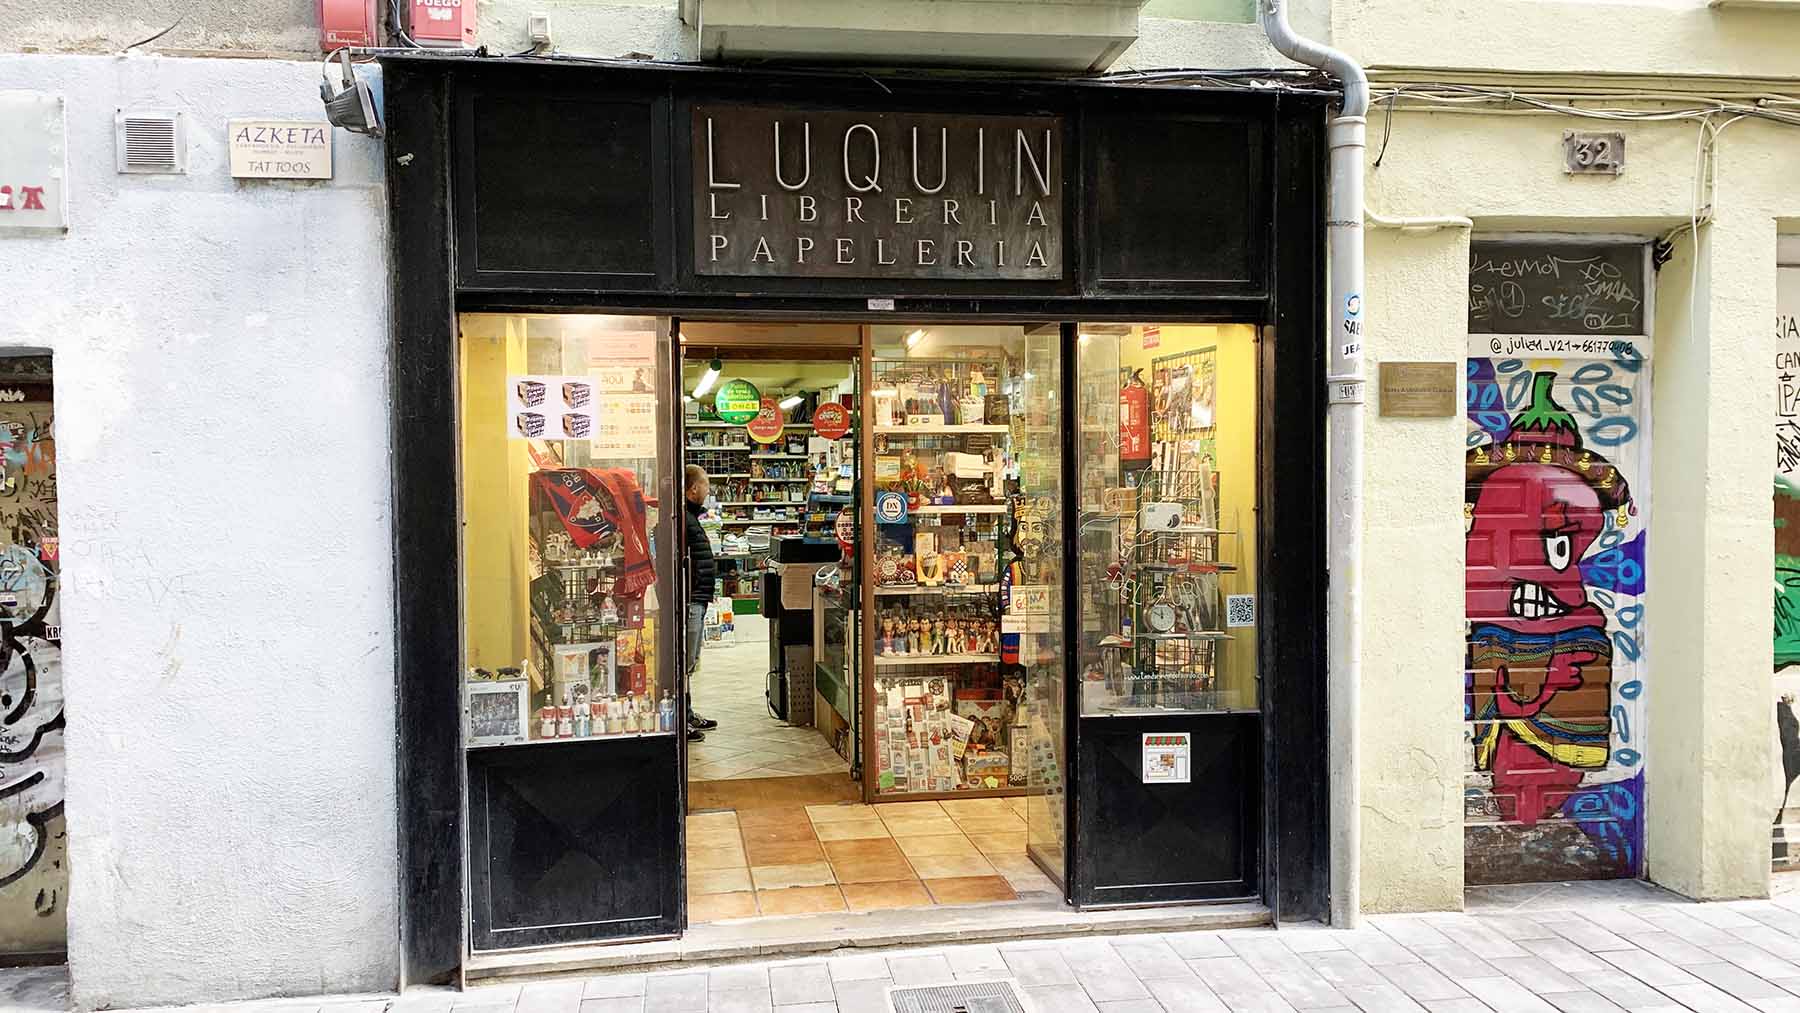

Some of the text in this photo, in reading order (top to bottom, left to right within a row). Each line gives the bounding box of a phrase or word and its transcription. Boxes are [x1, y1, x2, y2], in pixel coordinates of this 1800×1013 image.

[236, 127, 326, 145] AZKETA
[248, 160, 312, 174] TATTOOS
[706, 117, 1052, 197] LUQUIN
[709, 192, 1048, 226] LIBRERIA
[709, 234, 1048, 267] PAPELERIA
